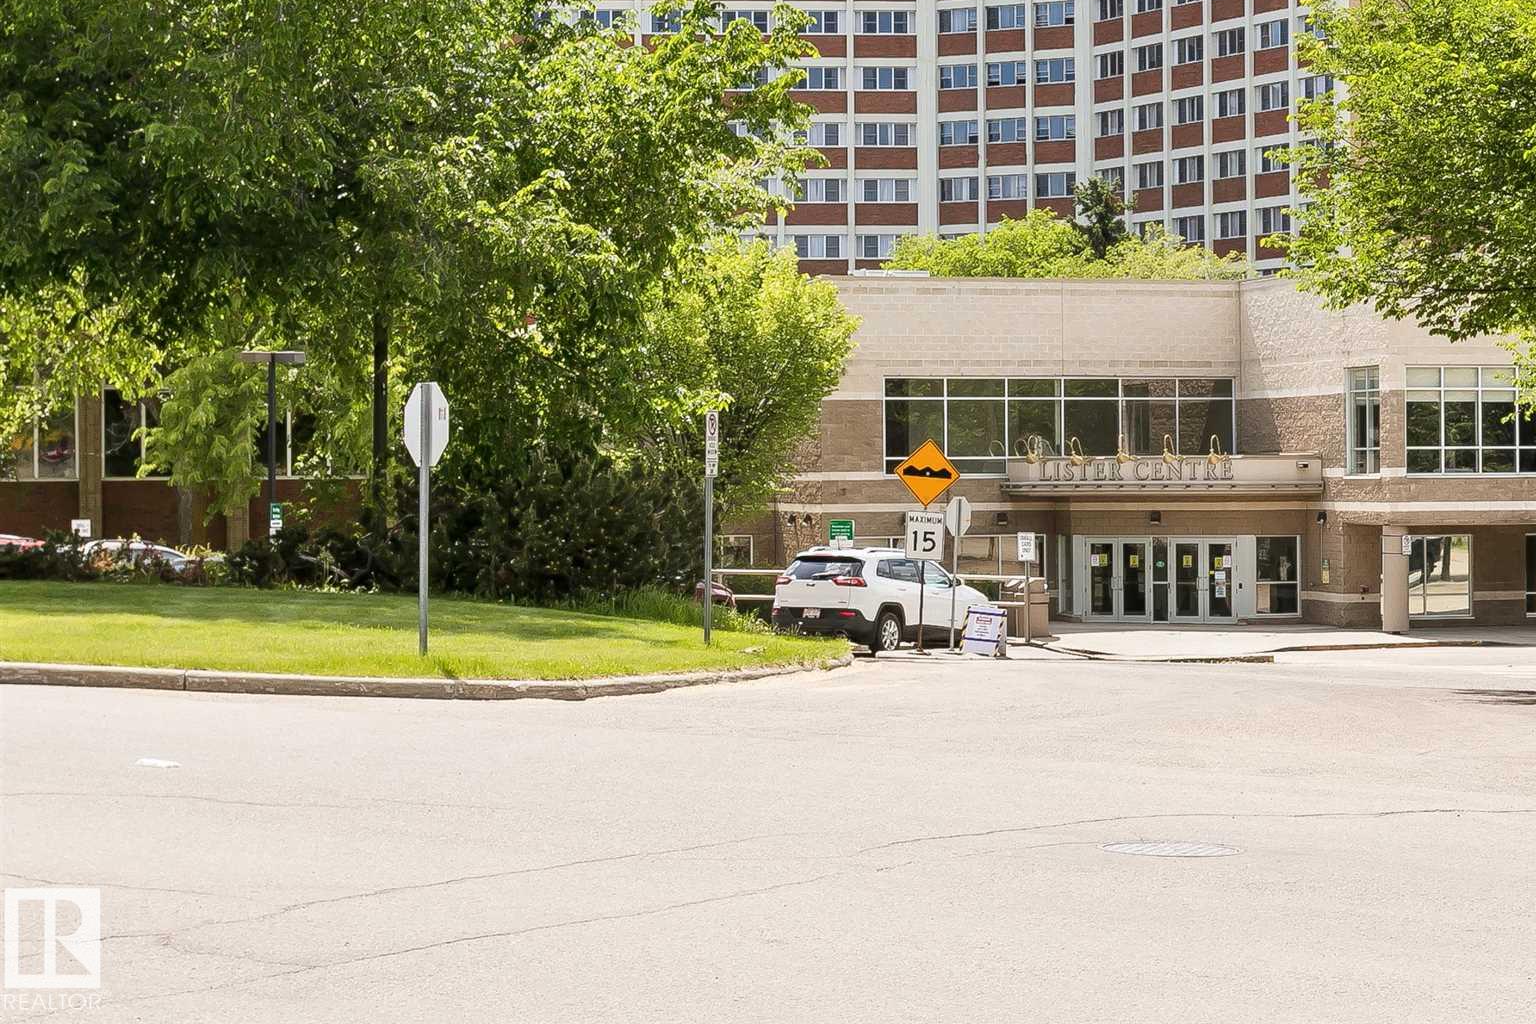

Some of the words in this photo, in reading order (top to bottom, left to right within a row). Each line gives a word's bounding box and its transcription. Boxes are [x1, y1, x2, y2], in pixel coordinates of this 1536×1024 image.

[1039, 460, 1124, 482] LISTER
[1135, 459, 1235, 481] CENTRE
[910, 516, 942, 525] MAXIMUM
[912, 530, 936, 552] 15
